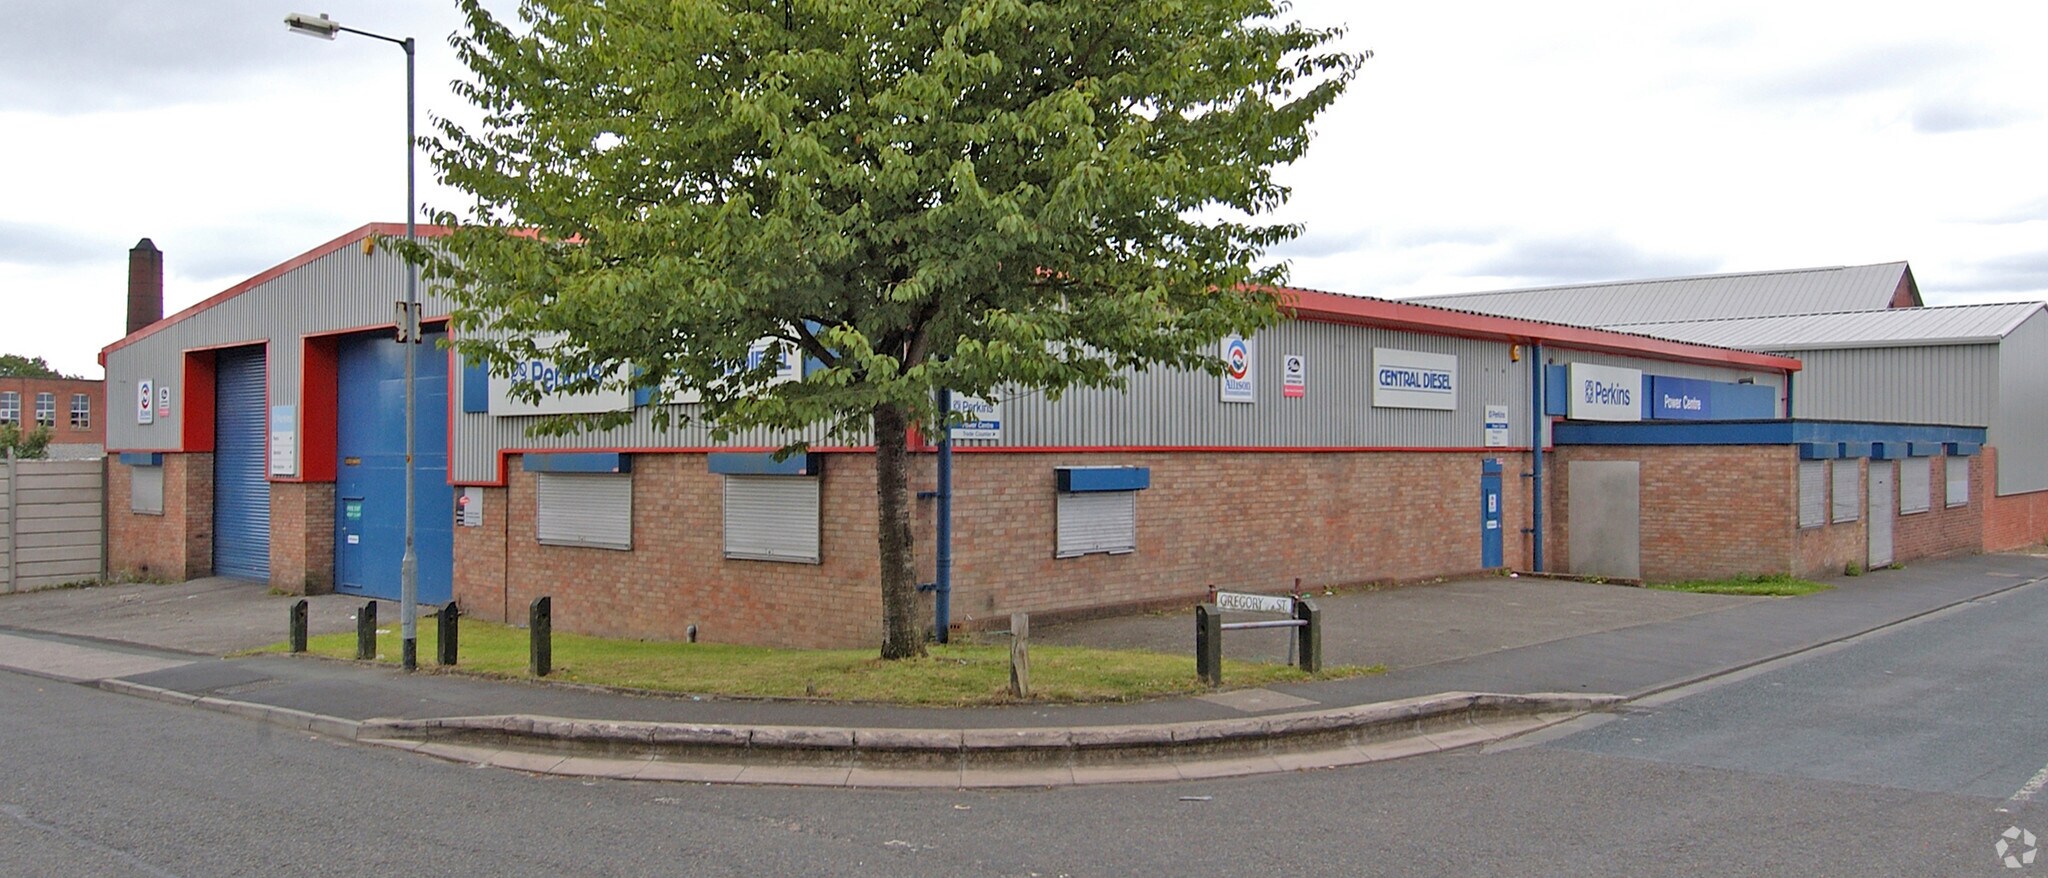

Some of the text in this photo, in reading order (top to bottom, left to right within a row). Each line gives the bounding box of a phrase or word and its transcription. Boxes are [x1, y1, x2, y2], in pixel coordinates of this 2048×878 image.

[1225, 379, 1251, 390] Allison
[1379, 369, 1452, 390] CENTRAL DIESEL
[1595, 381, 1630, 406] Perkins
[962, 400, 994, 413] Perkins
[1664, 394, 1702, 411] Power Centre
[1220, 594, 1264, 610] GREGORY
